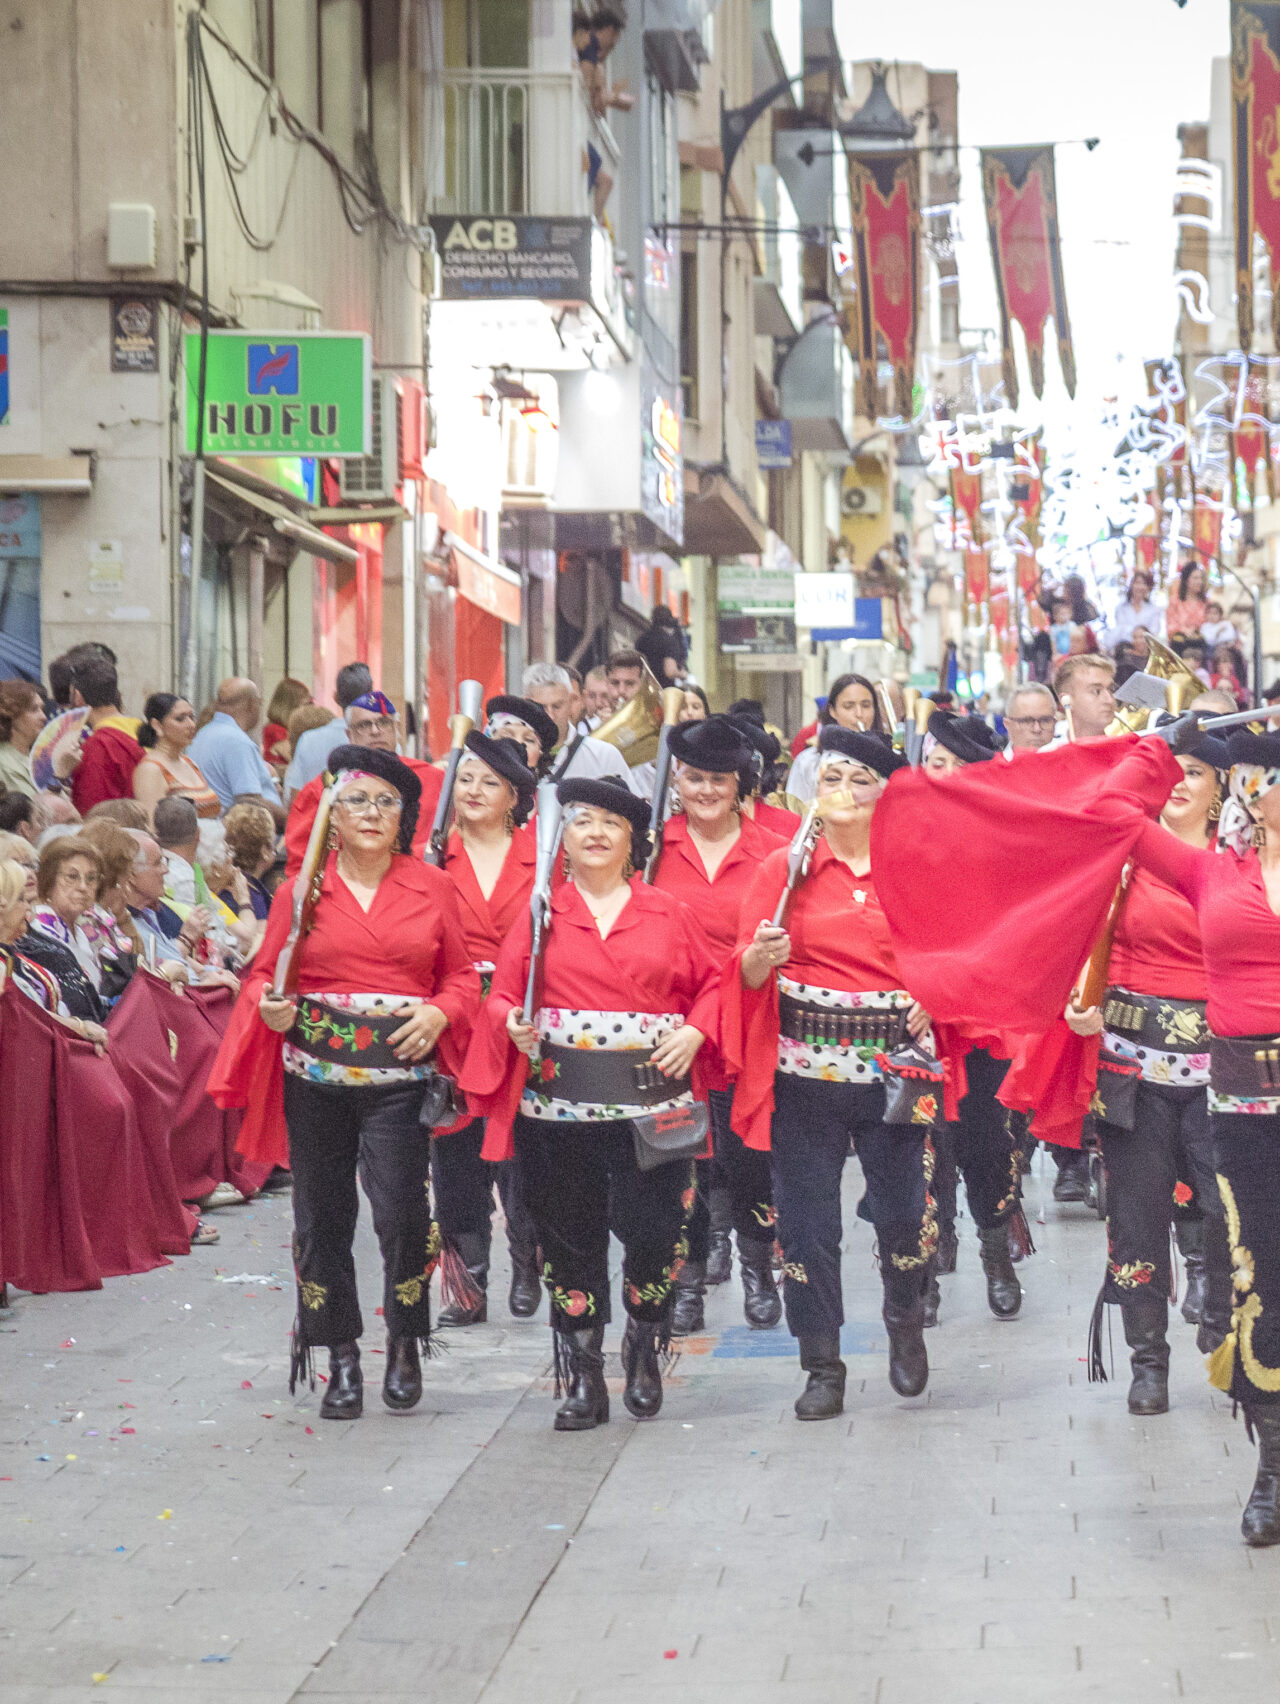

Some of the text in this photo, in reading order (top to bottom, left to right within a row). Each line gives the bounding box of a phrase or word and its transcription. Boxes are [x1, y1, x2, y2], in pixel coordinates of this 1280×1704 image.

[443, 219, 518, 250] ACB
[445, 252, 506, 265] DERECHO
[443, 265, 580, 280] CONSUMO Y SEGUROS
[208, 403, 337, 436] HOFU
